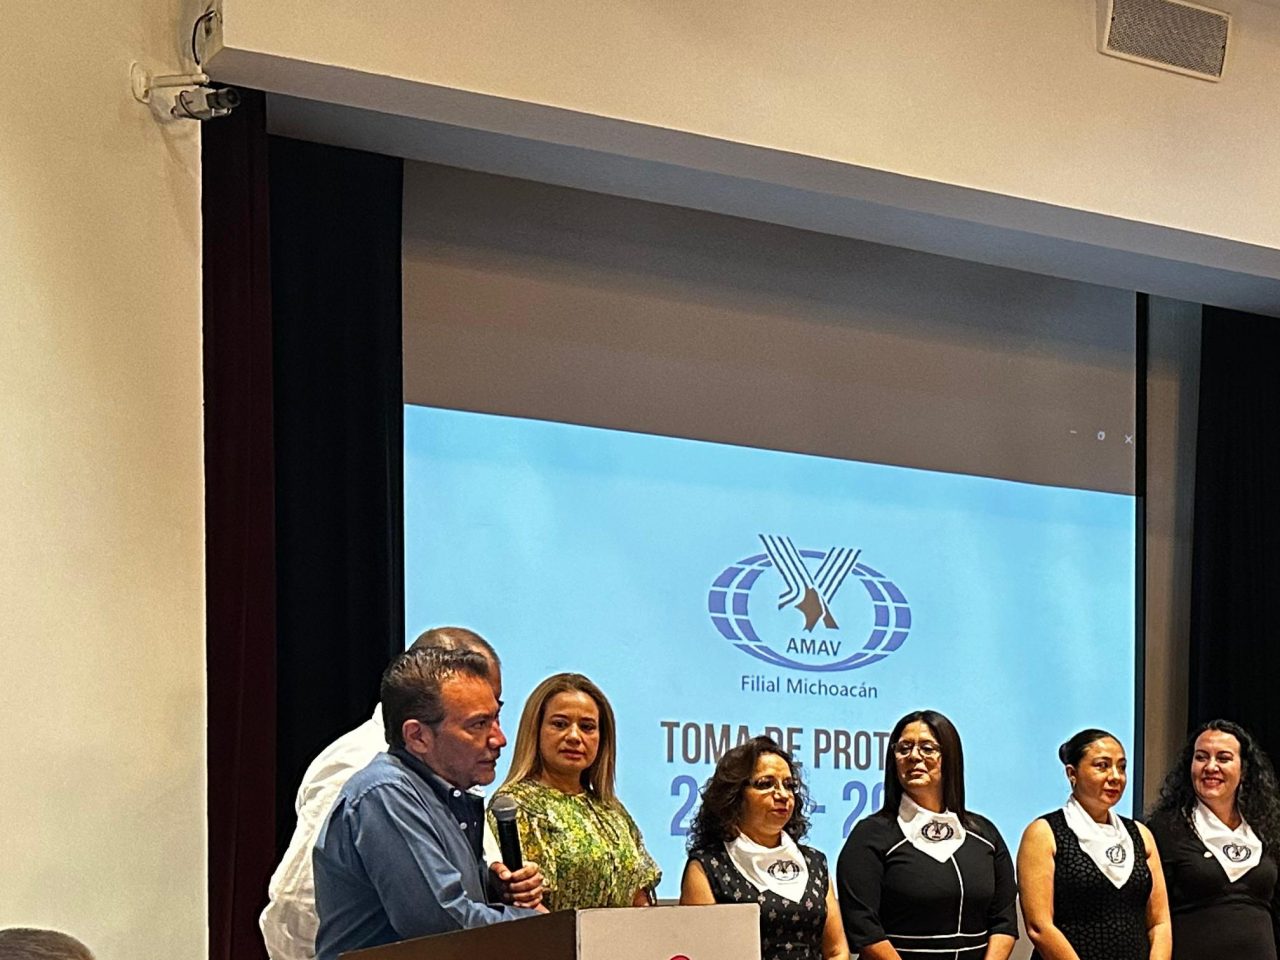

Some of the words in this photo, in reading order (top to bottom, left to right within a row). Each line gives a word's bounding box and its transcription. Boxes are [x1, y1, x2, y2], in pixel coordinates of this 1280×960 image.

[786, 637, 842, 657] AMAV
[741, 675, 780, 693] Filial
[787, 677, 878, 698] Michoacán
